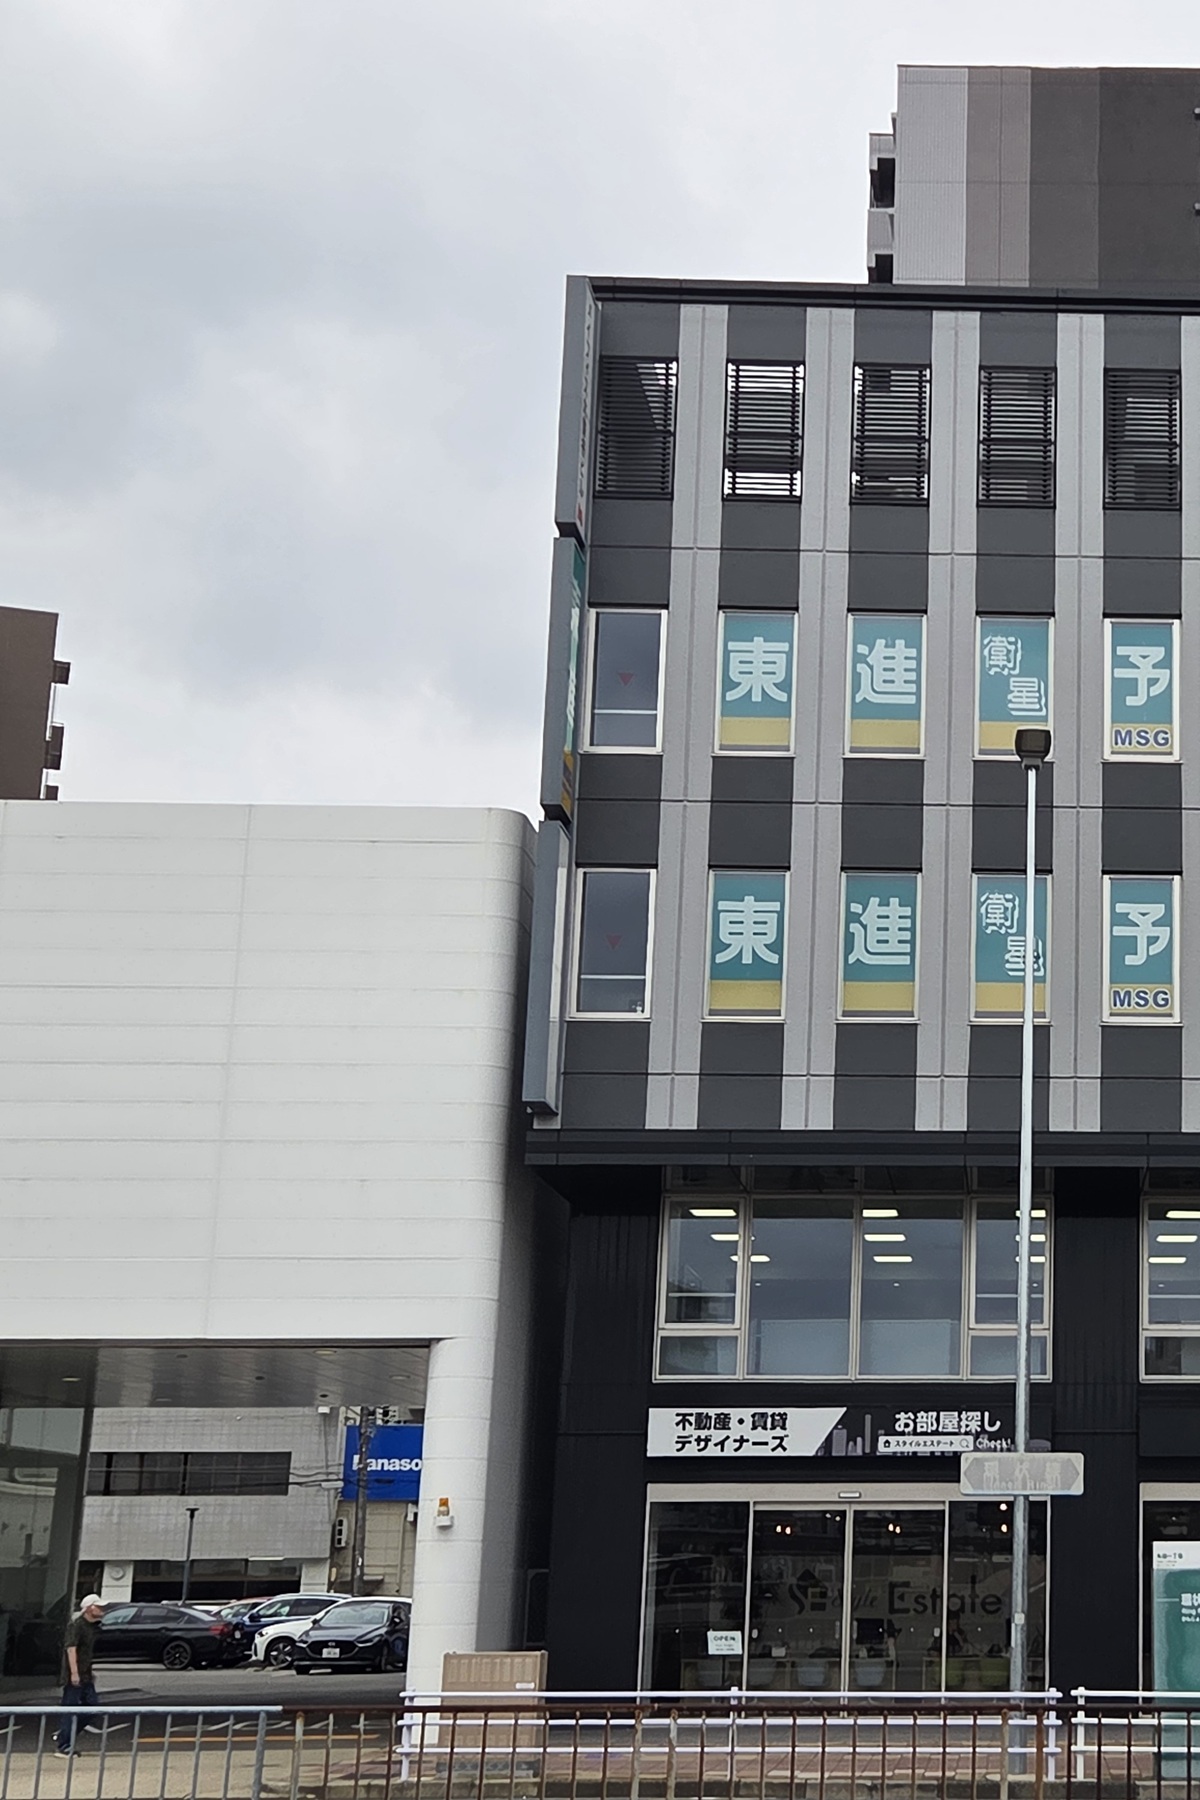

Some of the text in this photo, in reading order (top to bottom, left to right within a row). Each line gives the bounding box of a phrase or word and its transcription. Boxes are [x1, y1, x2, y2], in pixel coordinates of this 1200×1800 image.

[1113, 728, 1171, 747] MSG
[1112, 989, 1171, 1009] MSG
[675, 1412, 788, 1431] 不動産・賃貸
[894, 1411, 1001, 1433] お部屋探し
[675, 1434, 789, 1452] デザイナーズ
